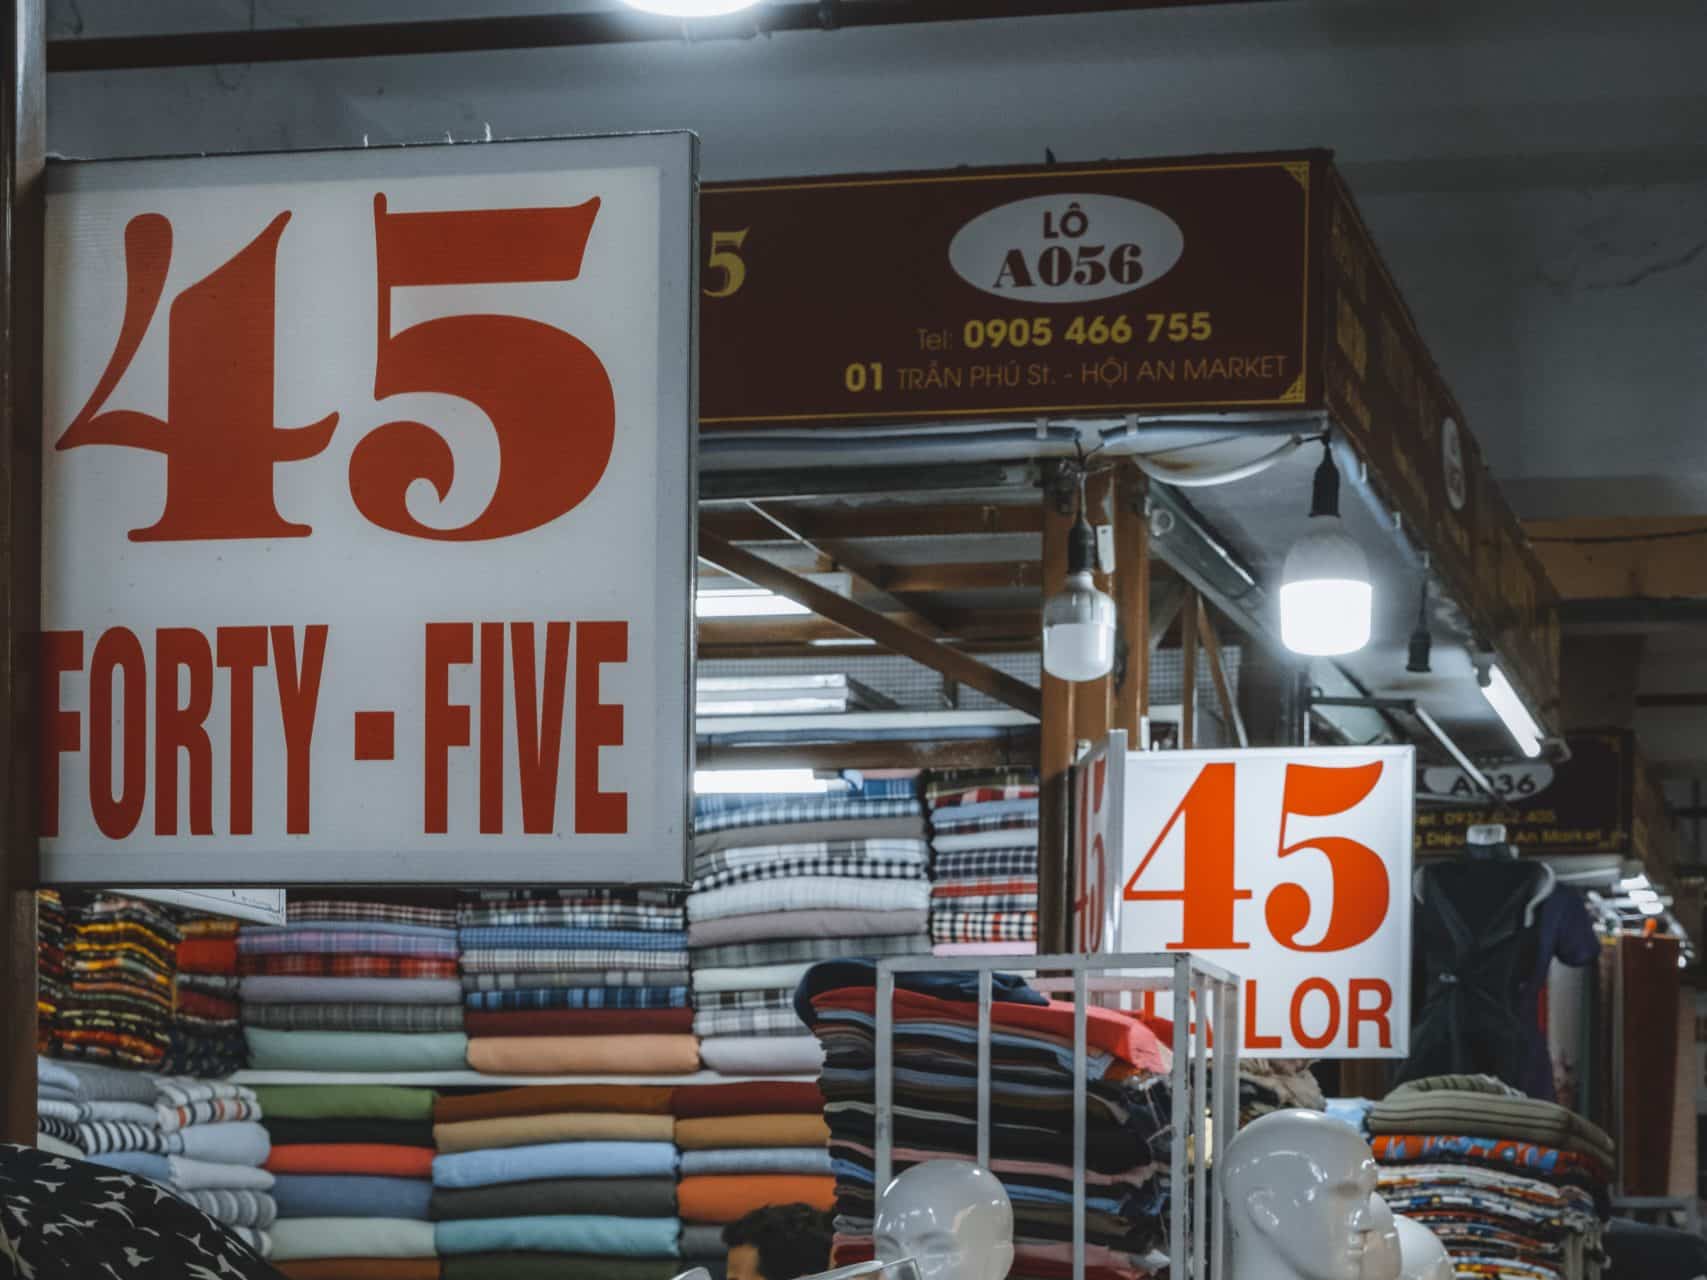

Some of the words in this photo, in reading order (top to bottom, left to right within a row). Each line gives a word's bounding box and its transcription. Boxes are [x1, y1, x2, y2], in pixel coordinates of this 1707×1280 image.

[1044, 202, 1088, 238] LÔ
[993, 243, 1143, 288] A056
[913, 328, 954, 351] Tel:
[962, 317, 1053, 349] 0905
[1064, 314, 1132, 345] 466
[1146, 311, 1213, 342] 755
[55, 192, 616, 542] 45
[845, 362, 885, 392] 01
[968, 358, 1019, 388] PHÚ
[1137, 359, 1175, 382] AN
[1183, 354, 1288, 380] MARKET
[40, 623, 329, 840] FORTY
[424, 621, 628, 834] FIVE
[1123, 760, 1390, 952] 45
